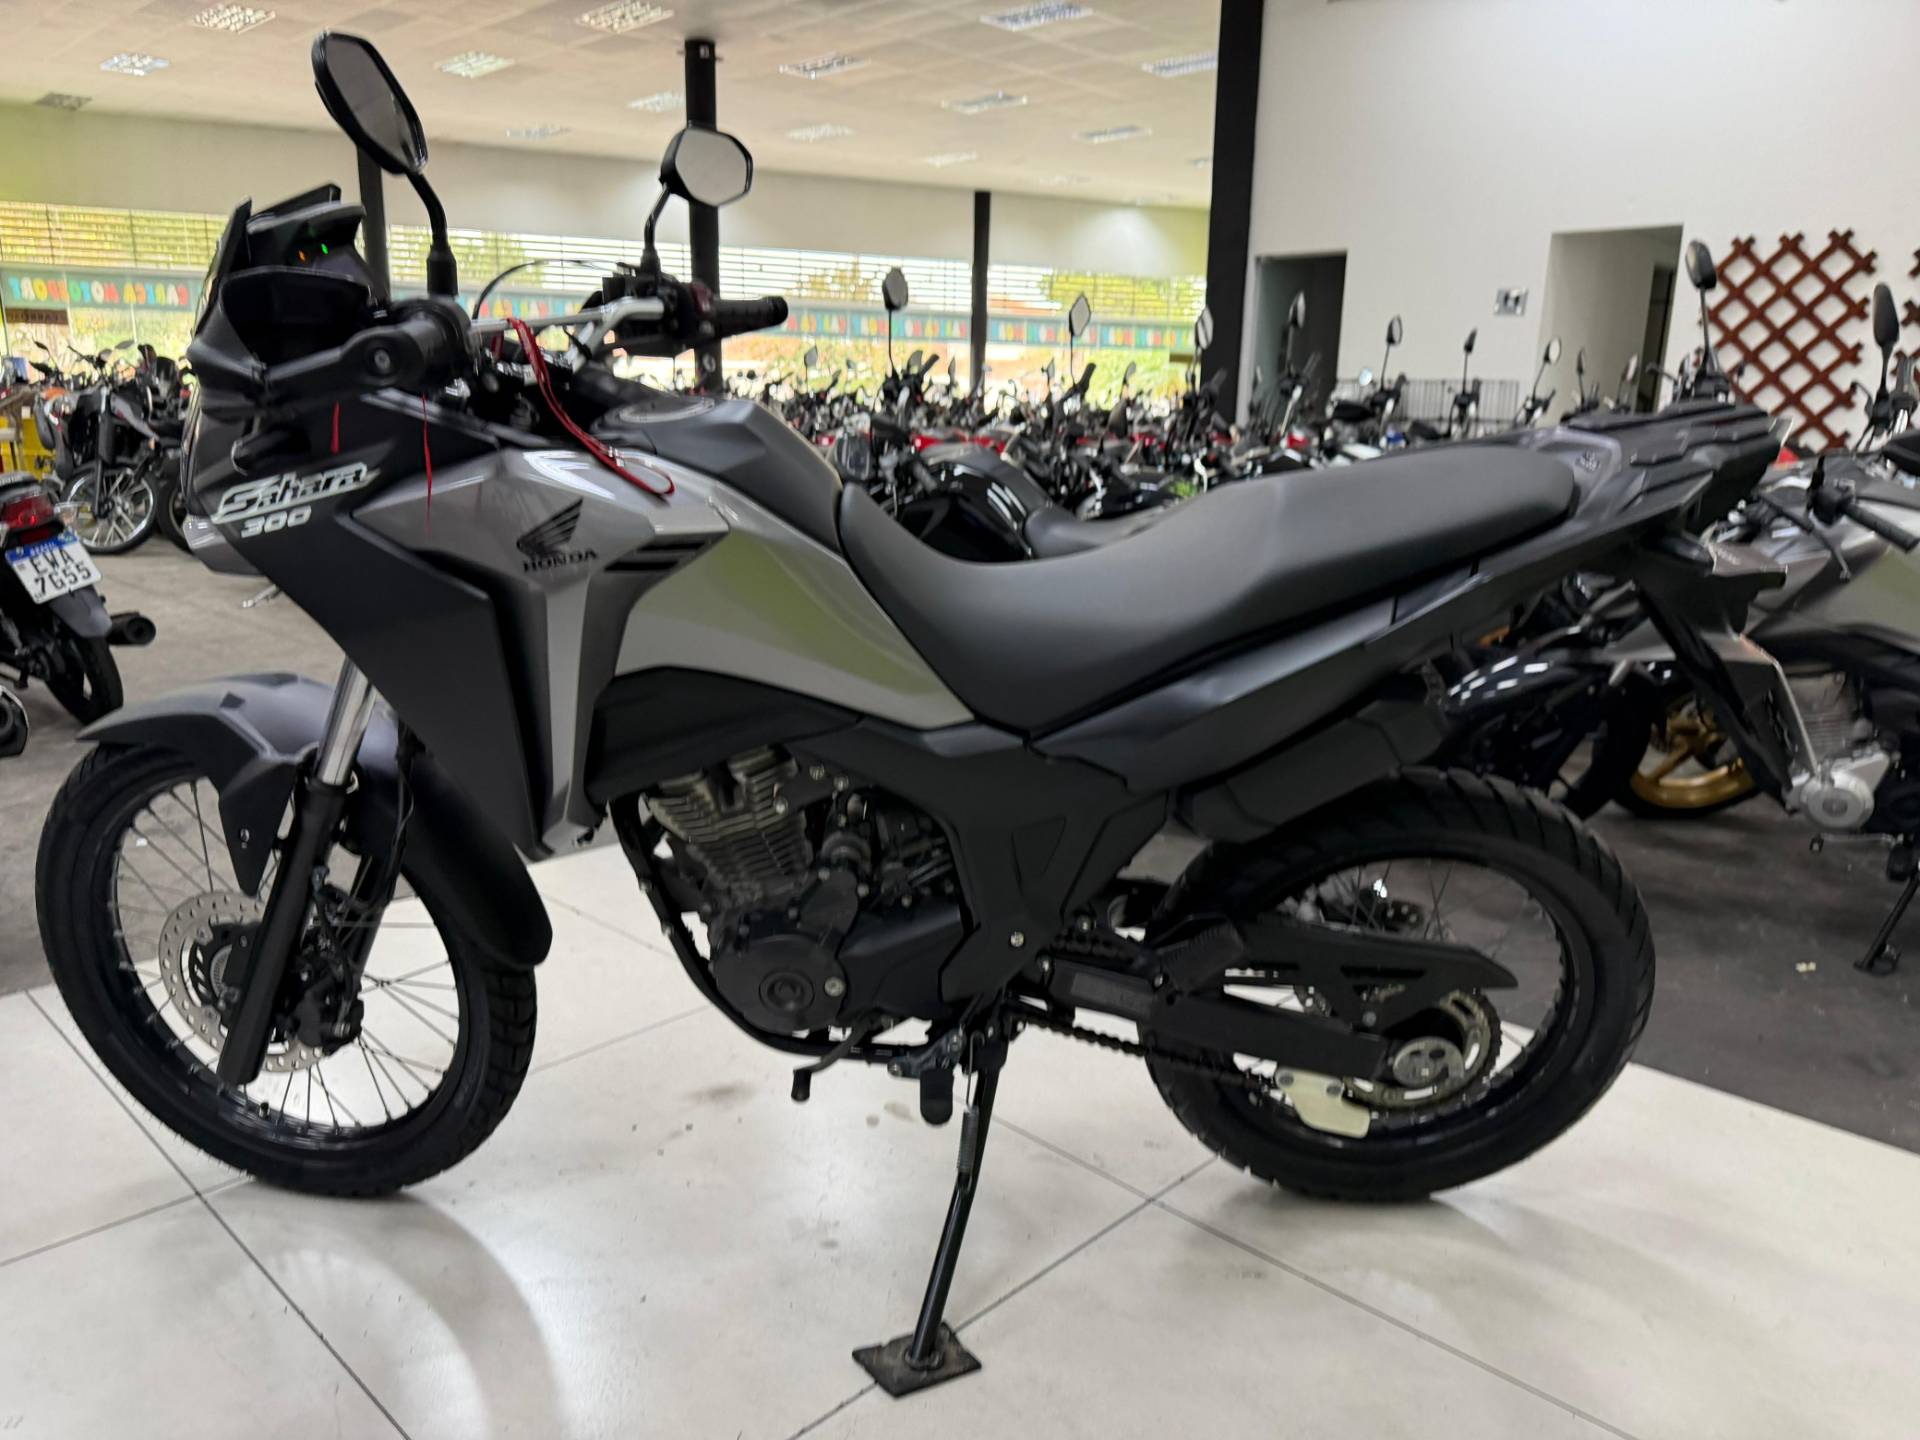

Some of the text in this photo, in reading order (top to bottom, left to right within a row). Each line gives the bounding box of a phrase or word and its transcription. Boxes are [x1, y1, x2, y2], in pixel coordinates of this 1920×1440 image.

[210, 461, 381, 524] Sahara
[240, 505, 312, 538] 300
[29, 548, 75, 575] EWA
[523, 548, 598, 573] HONDA
[34, 561, 91, 595] 7G55
